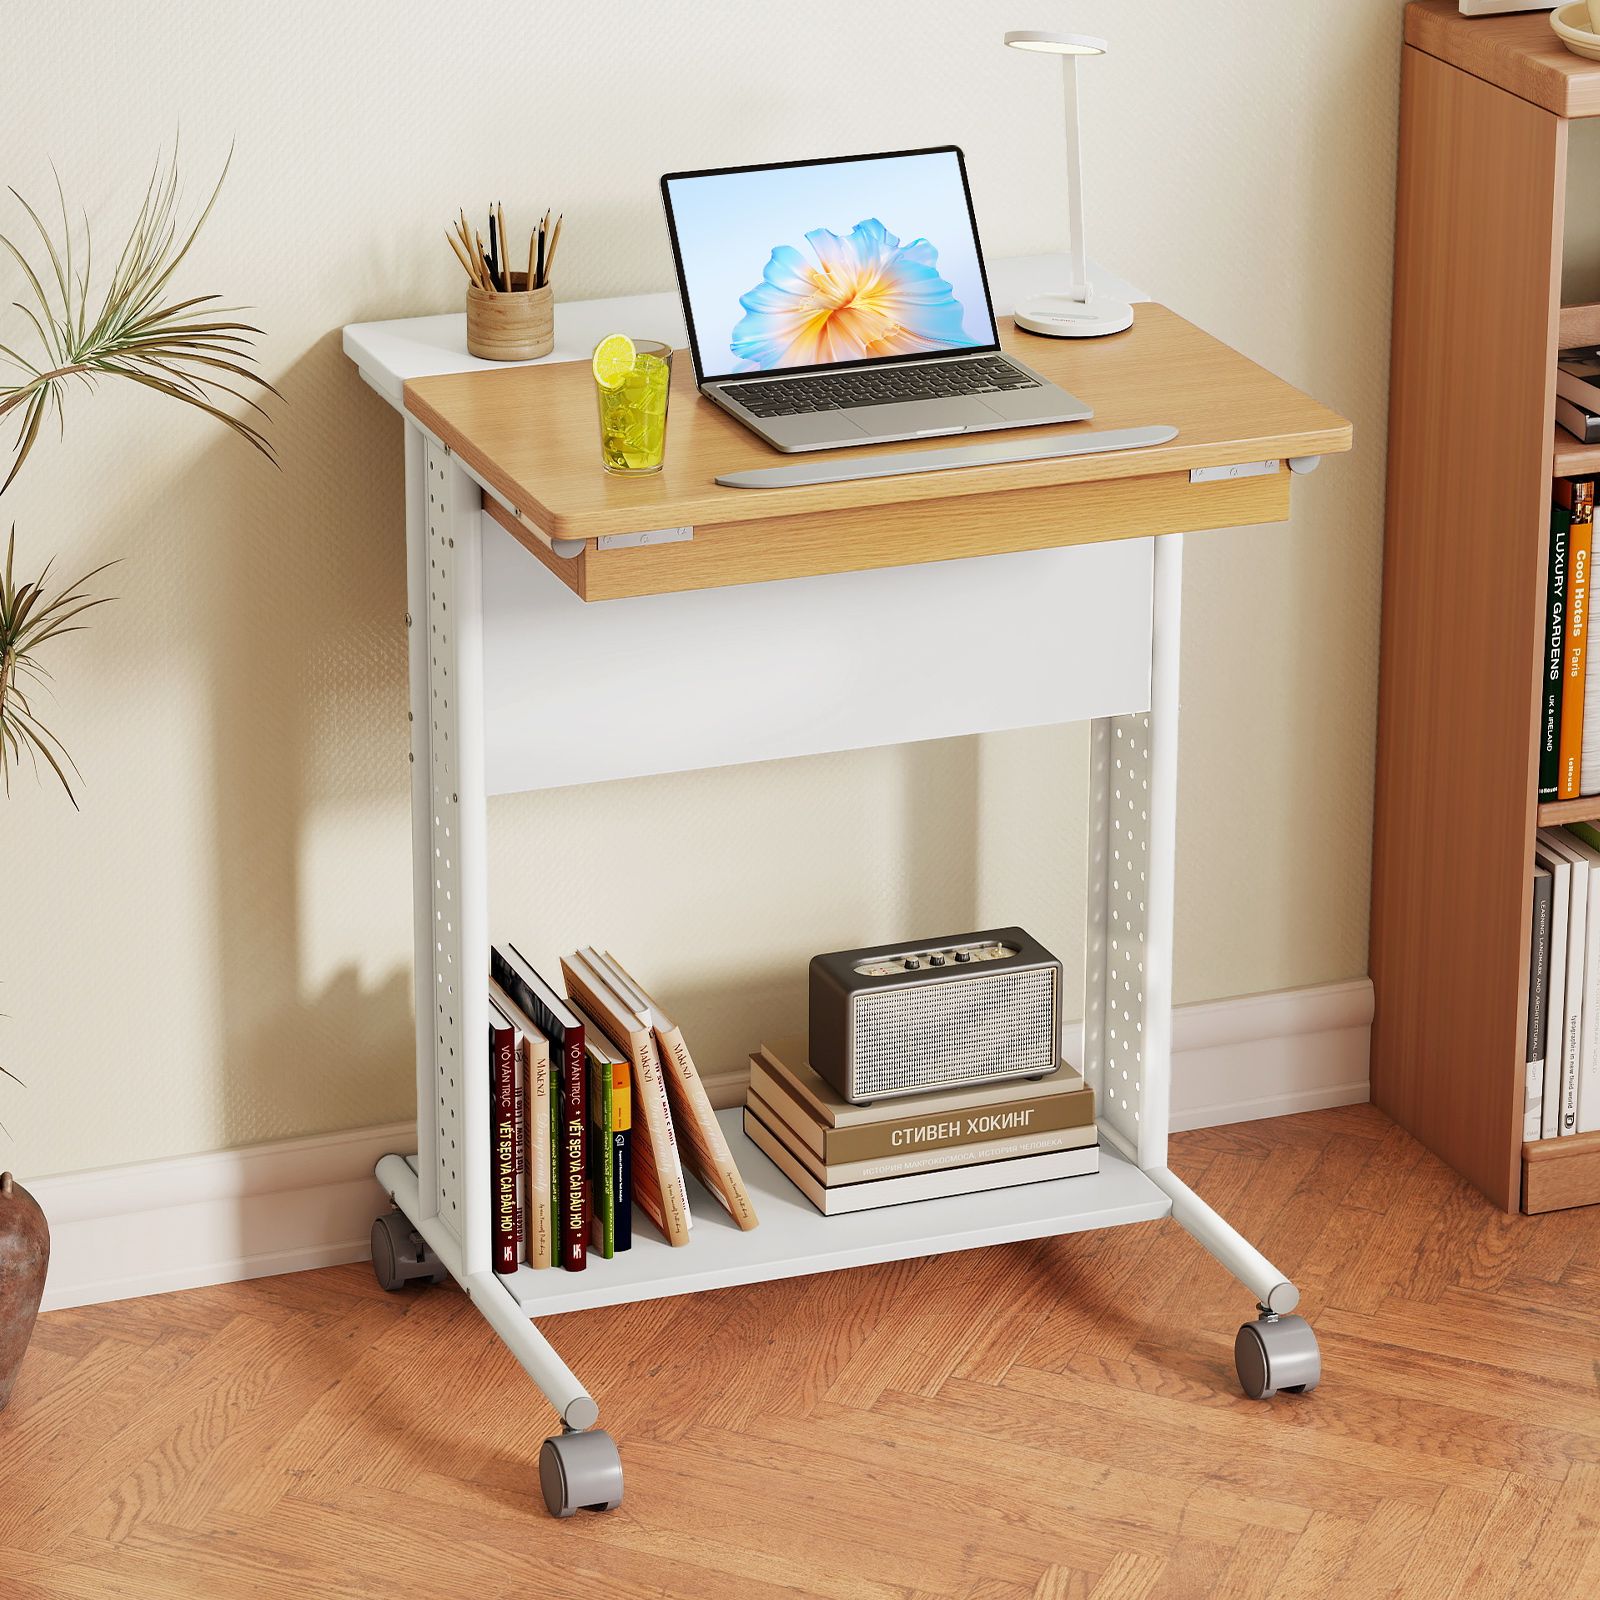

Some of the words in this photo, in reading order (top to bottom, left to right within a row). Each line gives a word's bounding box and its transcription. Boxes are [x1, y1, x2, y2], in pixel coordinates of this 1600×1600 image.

[1555, 532, 1565, 597] LUXURY
[1576, 549, 1587, 583] Cool
[1574, 587, 1585, 637] Hotels
[1550, 602, 1562, 680] GARDENS
[1571, 647, 1581, 677] Paris
[1549, 694, 1555, 707] UK
[891, 1120, 961, 1147] СТИВЕН
[965, 1109, 1035, 1136] ХОКИНГ
[497, 1141, 512, 1161] SẸO
[567, 1139, 582, 1158] SẸO
[862, 1162, 903, 1176] ИСТОРИЯ
[978, 1144, 1018, 1158] ИСТОРИЯ
[1019, 1138, 1063, 1152] ЧЕЛОВЕКА
[501, 1161, 515, 1175] VÀ
[570, 1159, 585, 1173] VÀ
